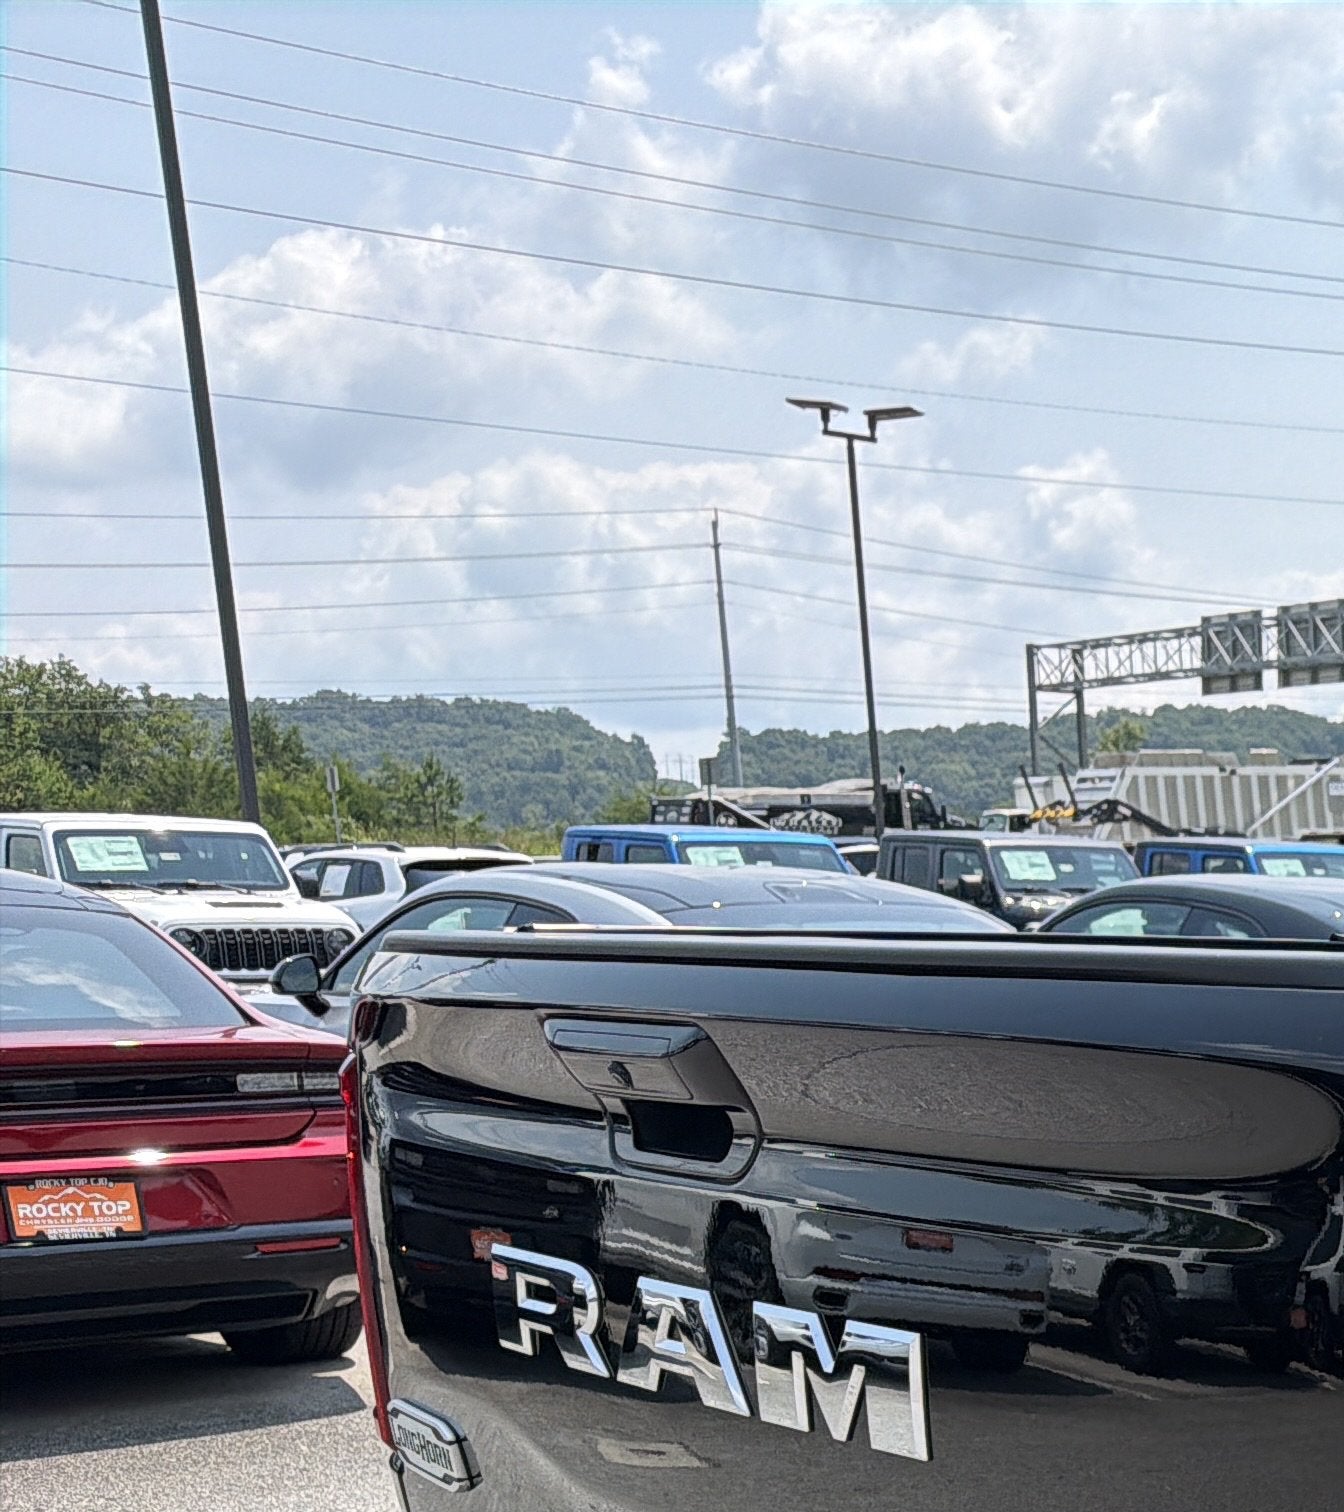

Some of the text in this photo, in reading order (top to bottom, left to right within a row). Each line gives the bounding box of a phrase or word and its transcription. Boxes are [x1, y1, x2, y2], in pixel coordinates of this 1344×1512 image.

[17, 1200, 131, 1218] ROCKY TOP
[491, 1241, 932, 1463] RAM
[390, 1417, 454, 1473] LONGHORN
